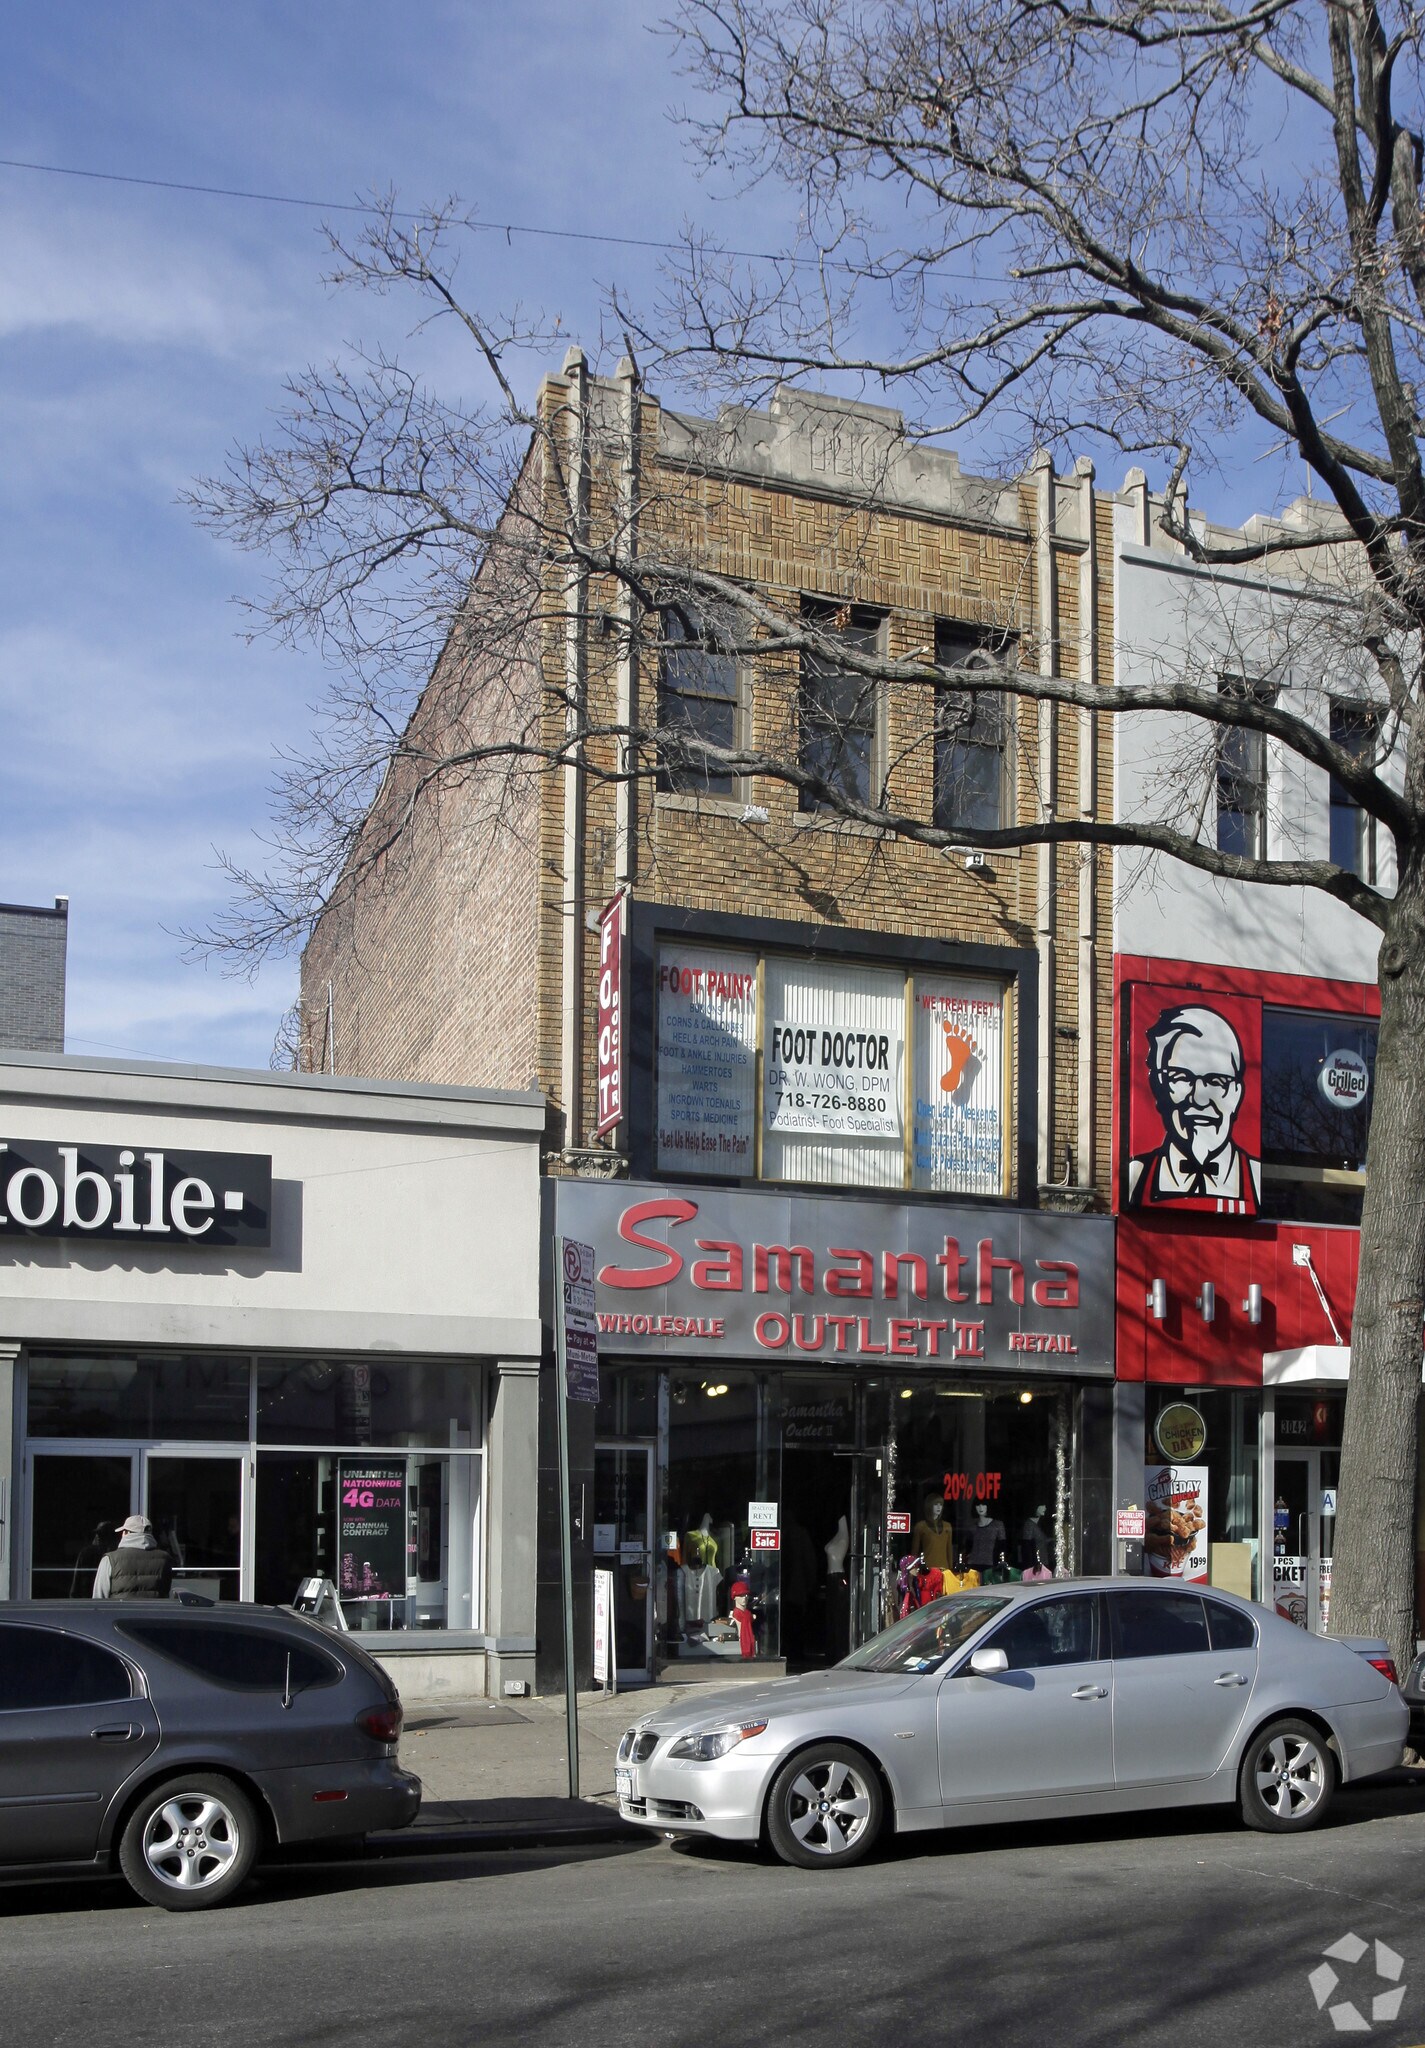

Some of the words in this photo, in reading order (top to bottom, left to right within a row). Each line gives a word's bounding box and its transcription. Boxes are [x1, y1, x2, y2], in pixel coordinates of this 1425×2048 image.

[659, 966, 702, 996] FOOT
[707, 970, 752, 1001] PAIN?
[922, 995, 936, 1010] WE
[939, 997, 968, 1013] TREAT
[971, 1000, 993, 1016] FEET
[600, 921, 611, 1114] FOOT
[666, 1015, 693, 1028] CORNS
[611, 990, 619, 1105] DOCTOR
[673, 1032, 692, 1044] HEEL
[700, 1035, 720, 1047] ARCH
[721, 1037, 738, 1048] PAIN
[772, 1027, 817, 1065] FOOT
[822, 1031, 889, 1070] DOCTOR
[659, 1046, 679, 1057] FOOT
[687, 1049, 712, 1061] ANKLE
[714, 1051, 747, 1065] INJURIES
[681, 1064, 733, 1079] HAMMERTOES
[1328, 1069, 1366, 1092] Grilled
[692, 1080, 718, 1093] WARTS
[769, 1069, 791, 1086] DR.
[794, 1072, 810, 1088] W.
[813, 1072, 858, 1092] WONG,
[862, 1076, 890, 1093] DPM
[668, 1094, 704, 1107] INGROWN
[706, 1097, 741, 1111] TOENAILS
[774, 1091, 886, 1113] 718-726-8880
[670, 1109, 700, 1122] SPORTS
[703, 1112, 738, 1126] MEDICINE
[960, 1103, 998, 1122] Weekends
[769, 1111, 819, 1128] Podiatrist-
[822, 1114, 845, 1129] Foot
[847, 1116, 895, 1133] Specialist
[674, 1131, 684, 1149] Us
[685, 1131, 700, 1155] Help
[701, 1132, 717, 1152] Ease
[719, 1133, 731, 1153] The
[0, 1143, 215, 1236] obile
[597, 1198, 1080, 1308] Samantha
[596, 1312, 725, 1339] WHOLESALE
[573, 1333, 582, 1346] Pay
[754, 1311, 949, 1357] OUTLET
[953, 1317, 985, 1361] II
[1009, 1332, 1078, 1354] RETAIL
[567, 1349, 597, 1363] Muni-Meter
[778, 1400, 844, 1418] Samantha
[1165, 1428, 1203, 1440] CHICKEN
[1281, 1420, 1306, 1434] 3042
[1172, 1437, 1195, 1453] DAY
[343, 1470, 402, 1478] UNLIMITED
[343, 1480, 402, 1488] NATIONWIDE
[943, 1473, 974, 1502] 20%
[976, 1472, 1001, 1500] OFF
[343, 1489, 374, 1508] 4G
[376, 1498, 401, 1508] DATA
[1323, 1493, 1333, 1509] A
[887, 1520, 906, 1530] Sale
[755, 1537, 776, 1547] Sale
[1162, 1560, 1182, 1569] KFC
[1278, 1557, 1294, 1565] PCS
[1273, 1566, 1307, 1582] CKET
